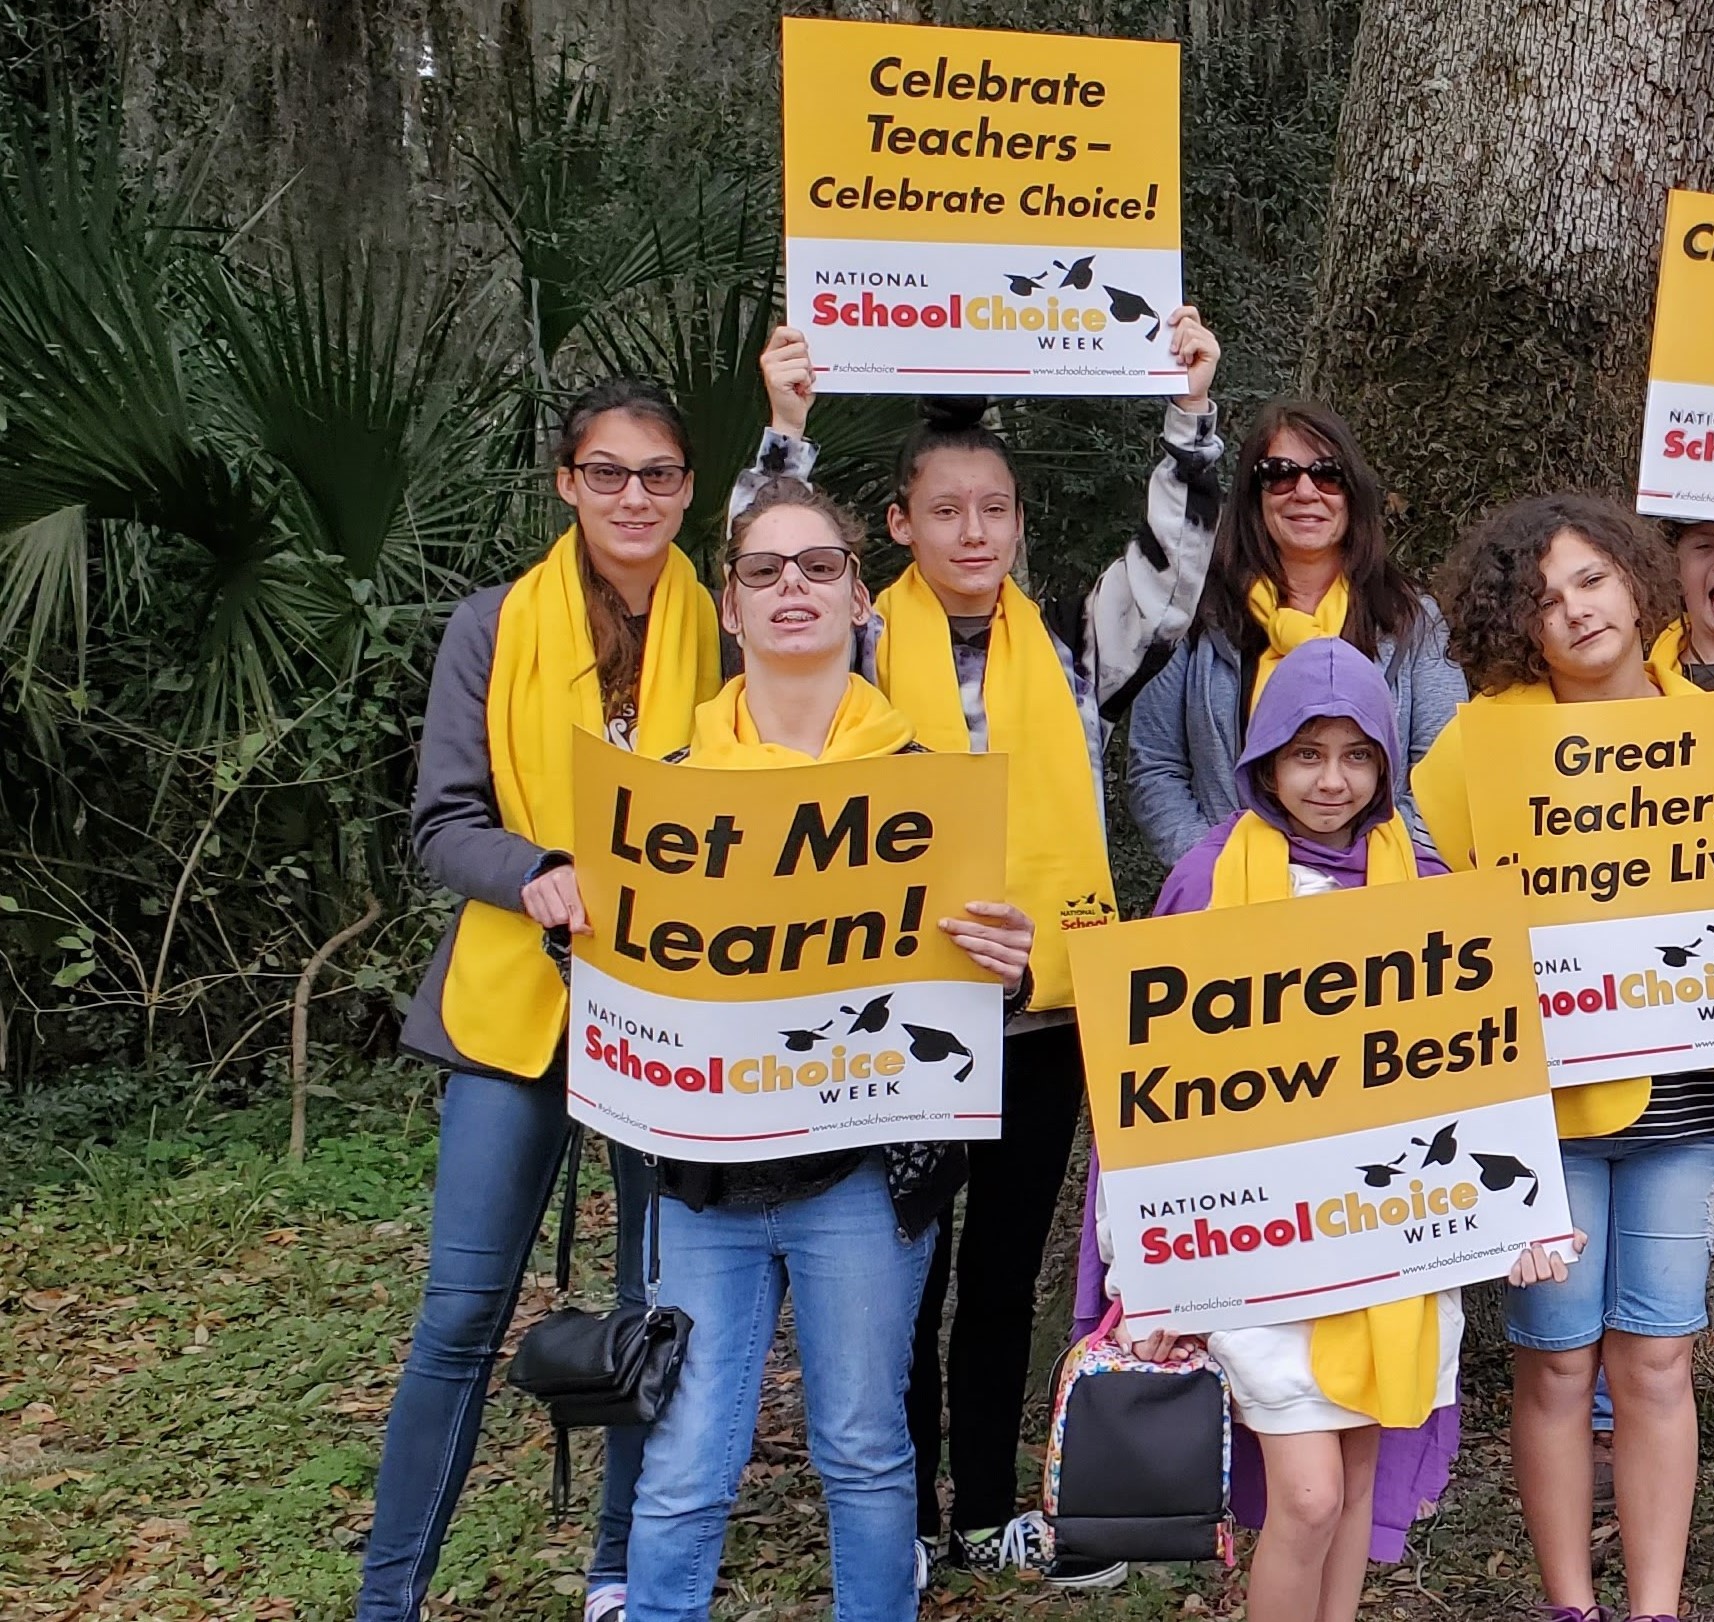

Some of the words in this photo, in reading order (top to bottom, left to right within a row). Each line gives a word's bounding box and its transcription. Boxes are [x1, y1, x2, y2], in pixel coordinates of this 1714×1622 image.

[869, 55, 1106, 108] Celebrate
[867, 114, 1077, 161] Teachers
[809, 174, 1005, 214] Celebrate
[1019, 183, 1158, 221] Choice!
[815, 270, 928, 287] NATIONAL
[1038, 336, 1104, 350] WEEK
[833, 363, 895, 374] #schoolchoice
[1033, 365, 1146, 377] www.schoolchoiceweek.com
[1555, 732, 1696, 777] Great
[610, 786, 743, 878] Let
[773, 795, 934, 877] Me
[1496, 853, 1651, 902] ange
[614, 885, 927, 976] Learn!
[1128, 930, 1493, 1046] Parents
[1533, 958, 1581, 975] ONAL
[588, 999, 684, 1047] NATIONAL
[1119, 1055, 1339, 1129] Know
[1363, 1007, 1519, 1089] Best!
[819, 1080, 900, 1105] WEEK
[811, 1110, 950, 1133] www.schoolchoiceweek.com
[1140, 1187, 1269, 1219] NATIONAL
[1404, 1215, 1478, 1244] WEEK
[1174, 1298, 1242, 1314] #schoolchoice
[1402, 1241, 1527, 1276] www.schoolchoiceweek.com
